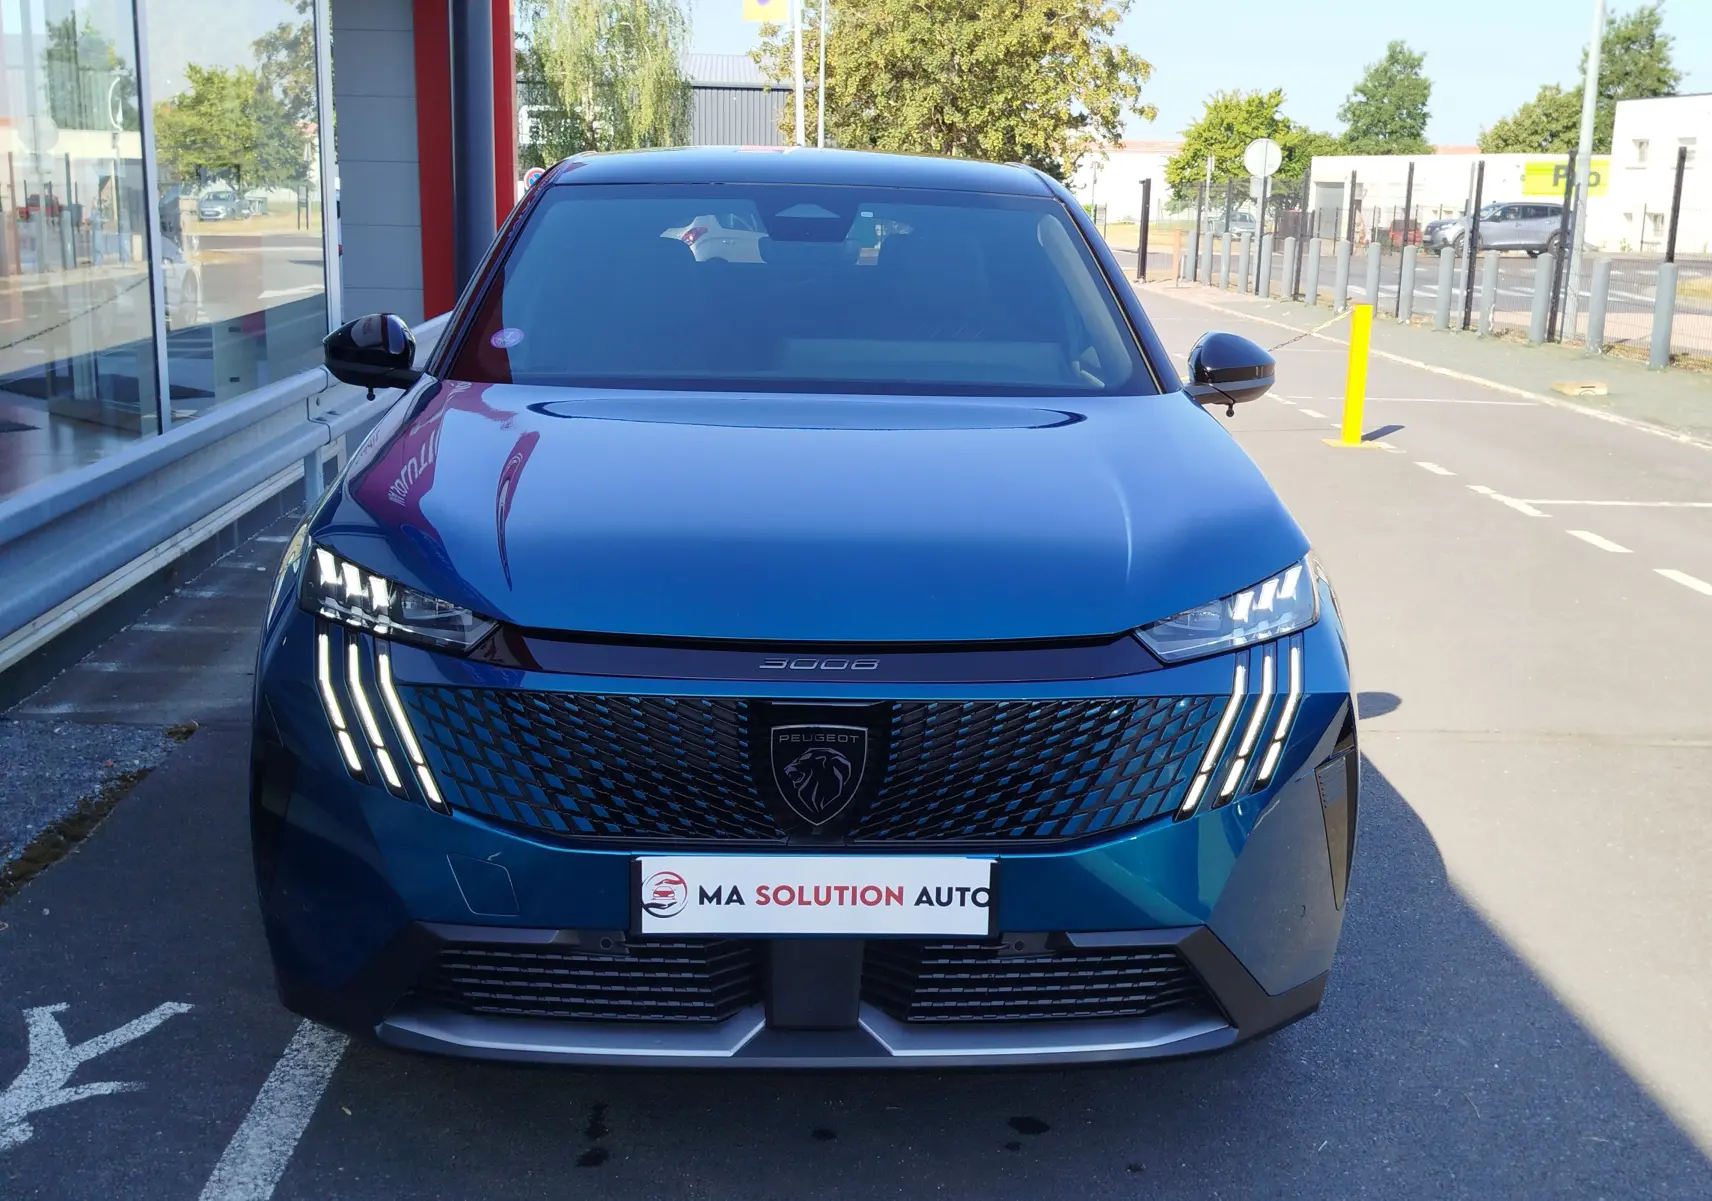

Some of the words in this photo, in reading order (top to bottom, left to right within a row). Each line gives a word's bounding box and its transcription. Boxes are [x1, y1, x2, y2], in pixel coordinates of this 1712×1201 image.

[1552, 164, 1601, 187] Po
[759, 657, 881, 670] 3008
[779, 733, 860, 744] PEUGEOT
[699, 885, 745, 906] MA
[755, 885, 904, 907] SOLUTION
[914, 886, 992, 907] AUTO
